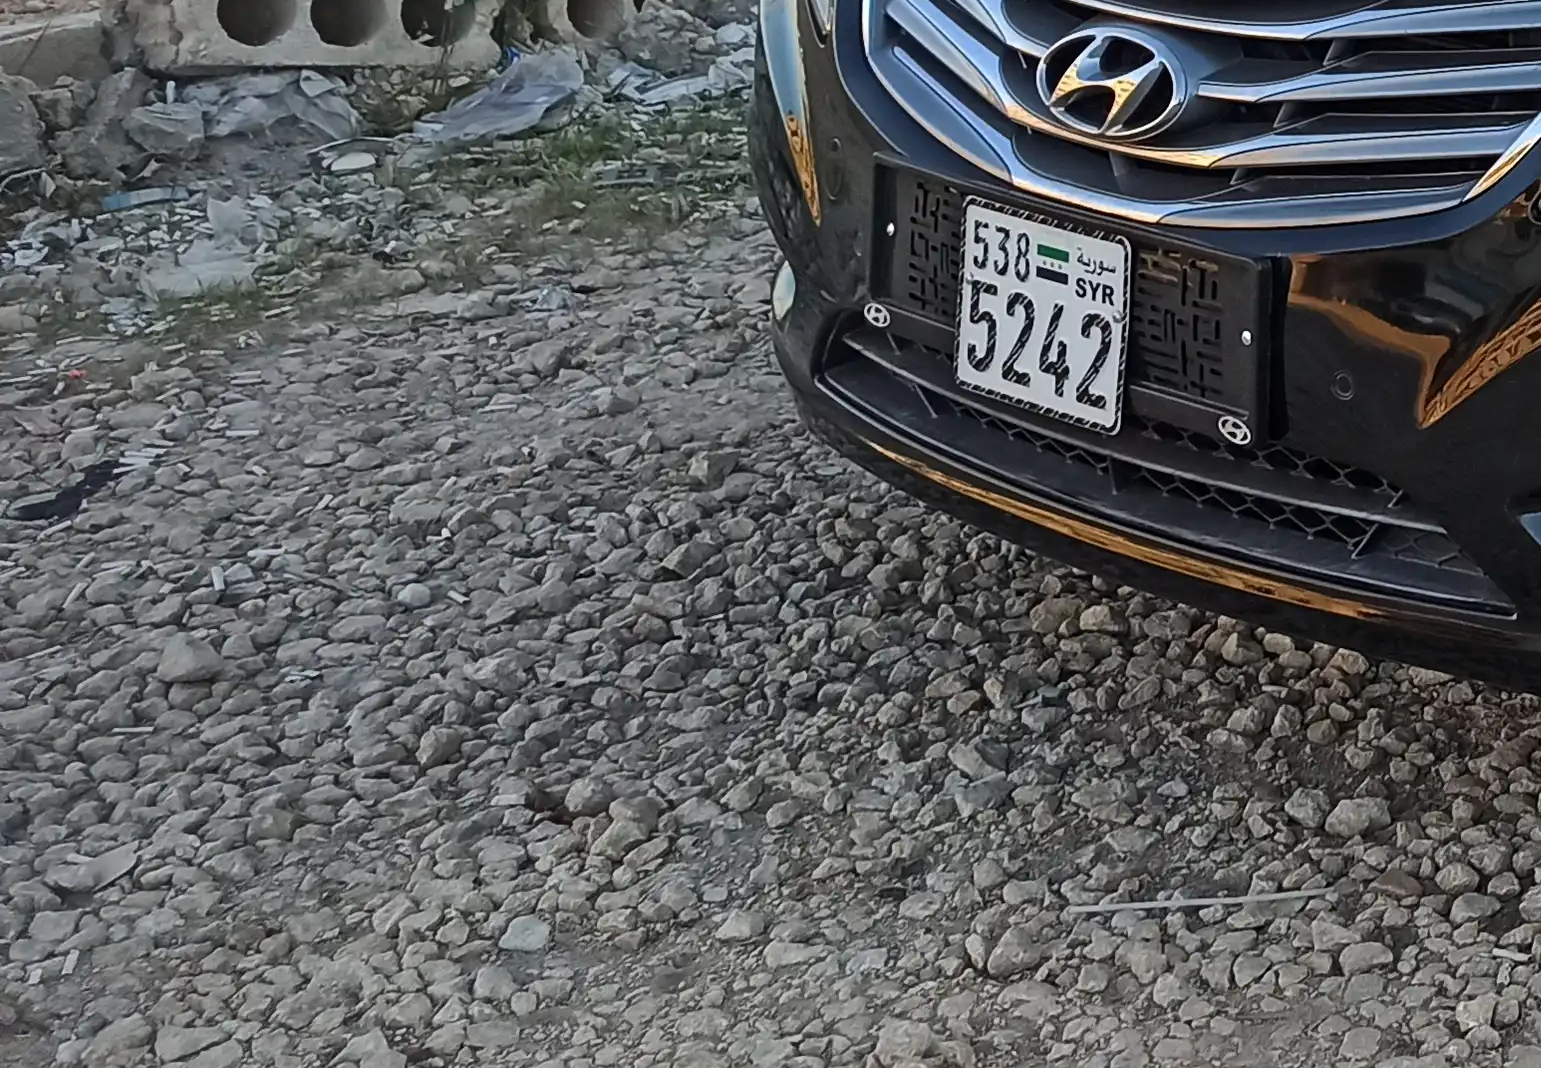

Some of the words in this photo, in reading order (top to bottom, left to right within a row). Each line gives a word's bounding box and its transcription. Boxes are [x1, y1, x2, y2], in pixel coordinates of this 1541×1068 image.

[973, 219, 1031, 283] 538
[1076, 246, 1117, 276] سورية
[1074, 277, 1115, 306] SYR
[966, 279, 1113, 411] 5242
